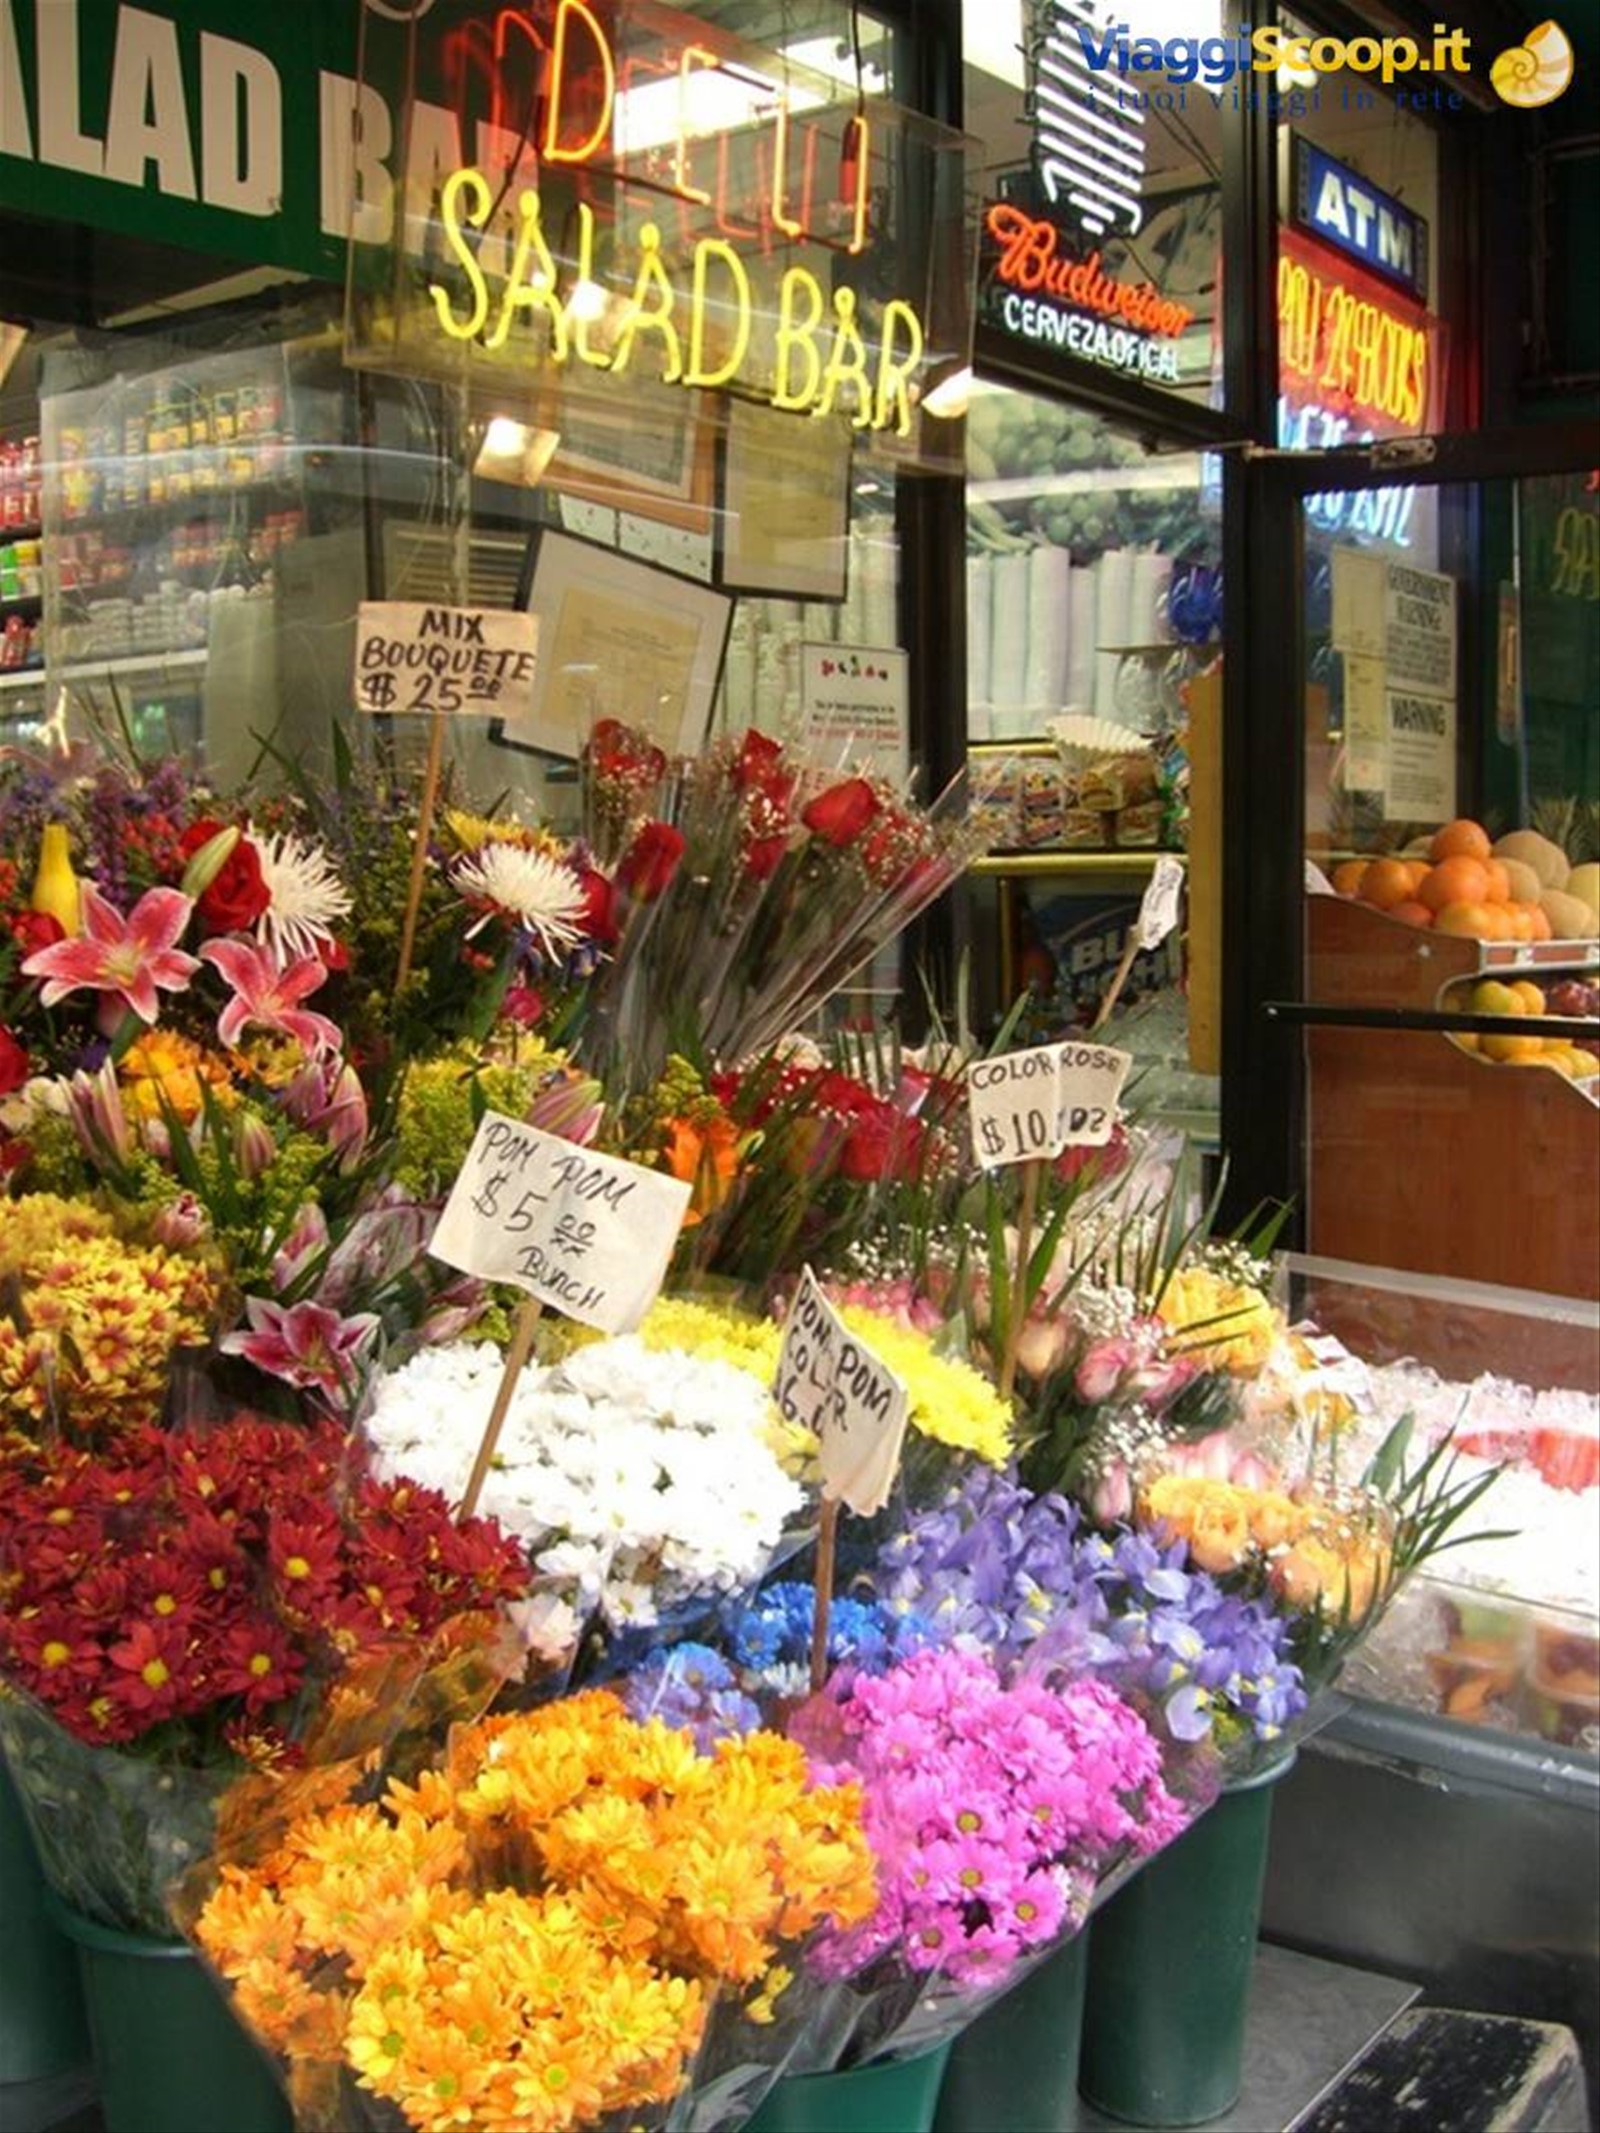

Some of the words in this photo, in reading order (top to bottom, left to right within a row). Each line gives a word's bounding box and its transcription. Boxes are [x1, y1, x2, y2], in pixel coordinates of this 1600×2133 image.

[320, 69, 540, 280] BAR
[1315, 169, 1413, 277] ATM
[429, 168, 750, 386] SALAD
[771, 268, 923, 437] BAR
[1003, 293, 1110, 356] CERVEZA
[360, 636, 536, 682] BOUQUETE
[418, 609, 485, 644] MIX
[971, 1052, 1055, 1090] COLOR
[1059, 1046, 1121, 1075] ROSE
[477, 1122, 540, 1173] POM
[551, 1155, 637, 1212] POM
[793, 1277, 833, 1350] POM
[835, 1343, 893, 1423] POM
